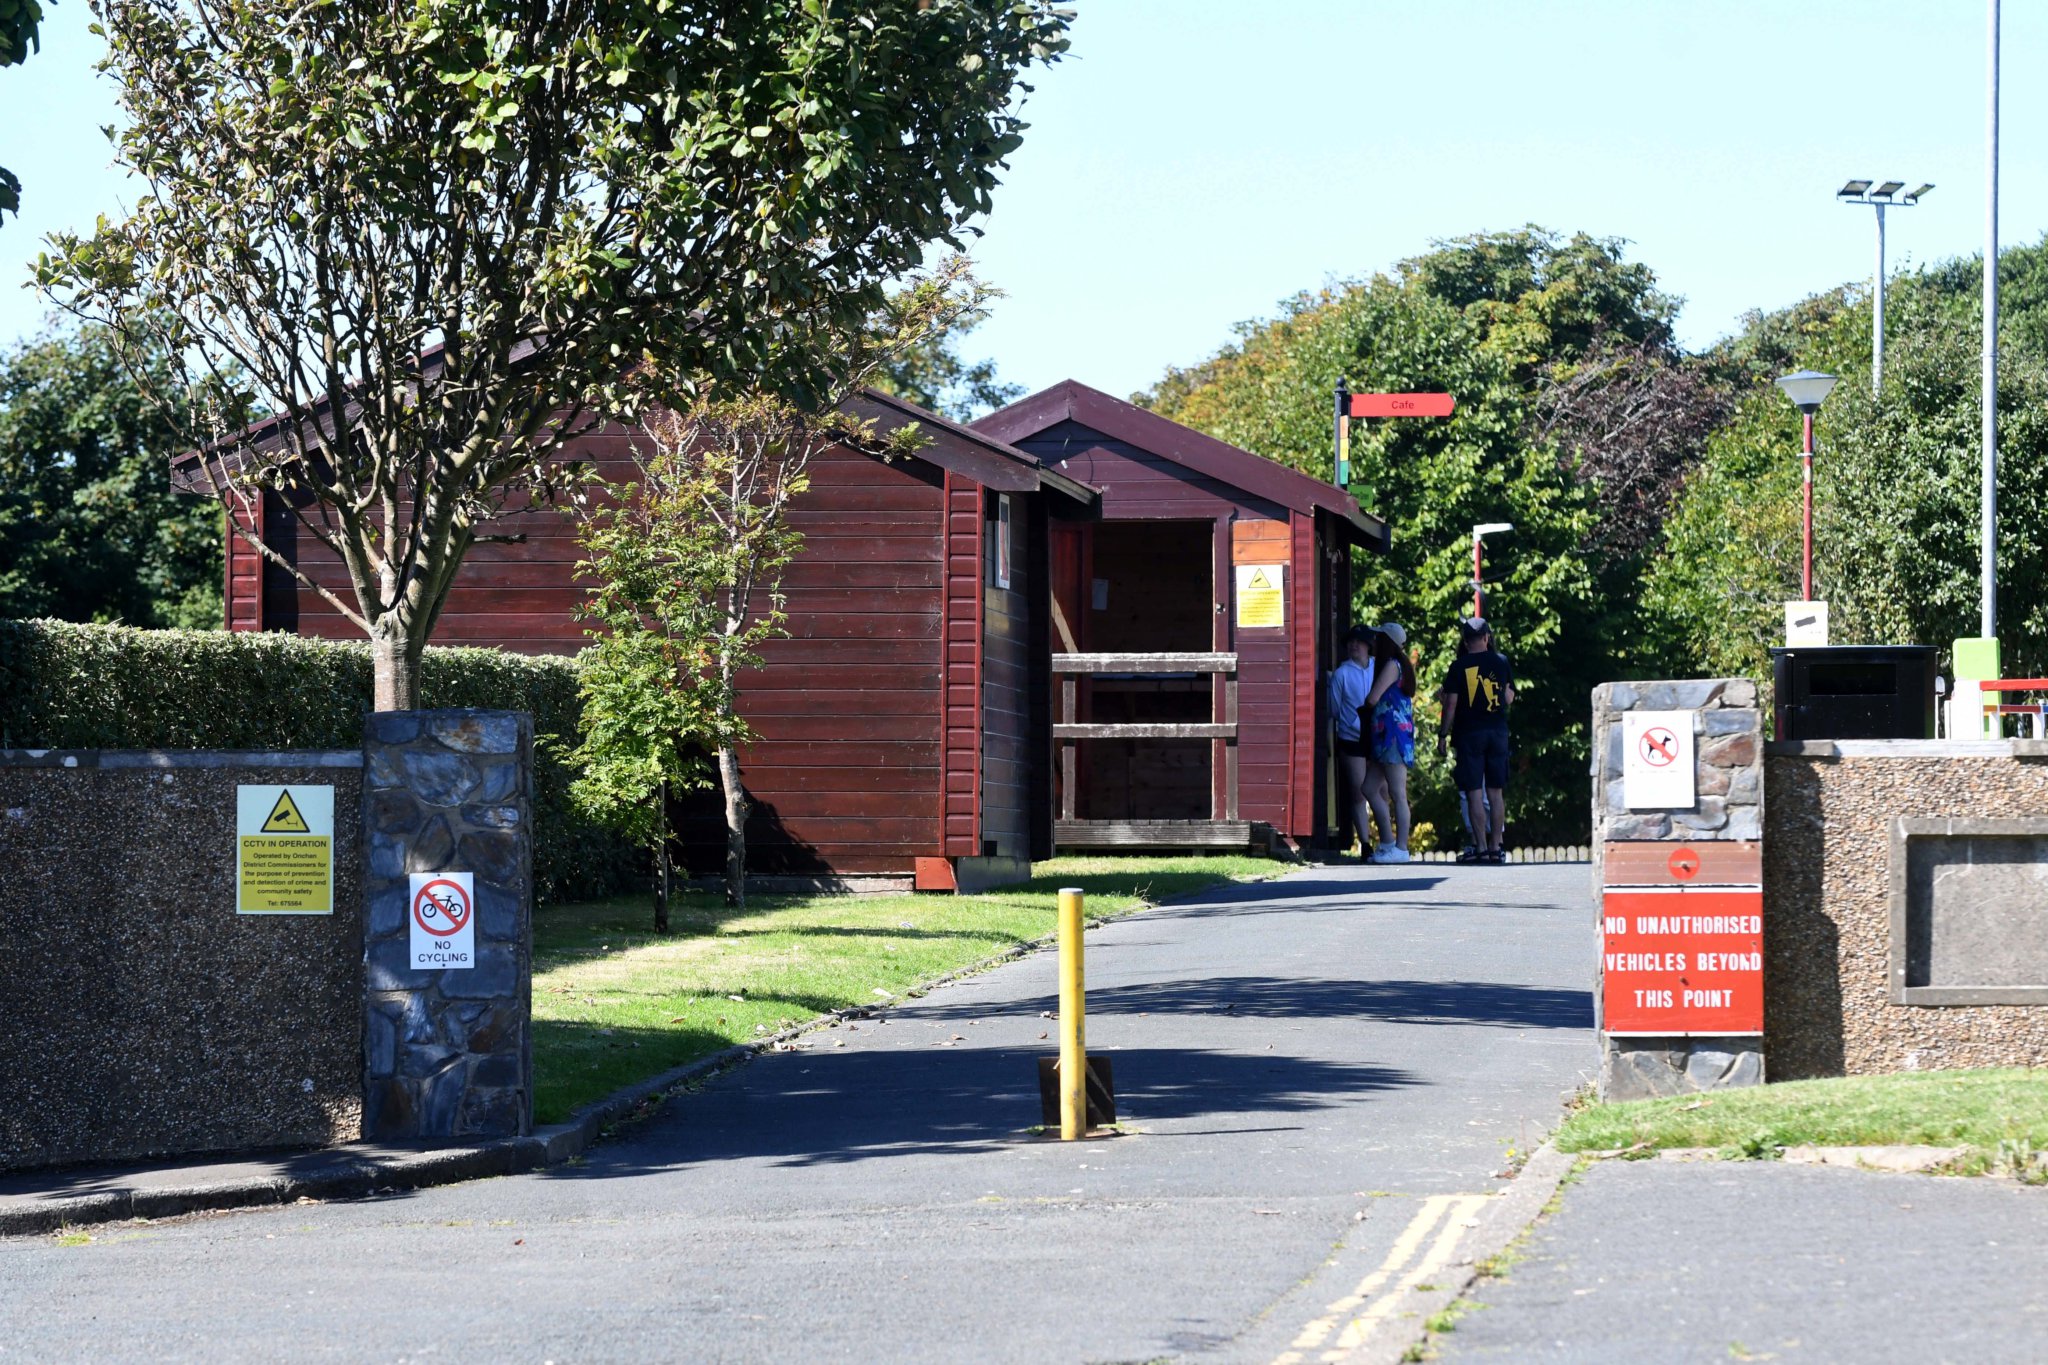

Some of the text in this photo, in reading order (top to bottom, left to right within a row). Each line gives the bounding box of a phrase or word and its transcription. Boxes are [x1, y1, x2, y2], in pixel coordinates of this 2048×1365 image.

[1391, 400, 1415, 410] Cafe
[243, 840, 266, 848] CCTV
[278, 840, 327, 848] OPERATION
[1605, 916, 1761, 935] NO UNAUTHORISED
[435, 941, 451, 950] NO
[418, 953, 468, 962] CYCLING
[1606, 953, 1762, 971] VEHICLES BEYOND
[1634, 990, 1733, 1008] THIS POINT
